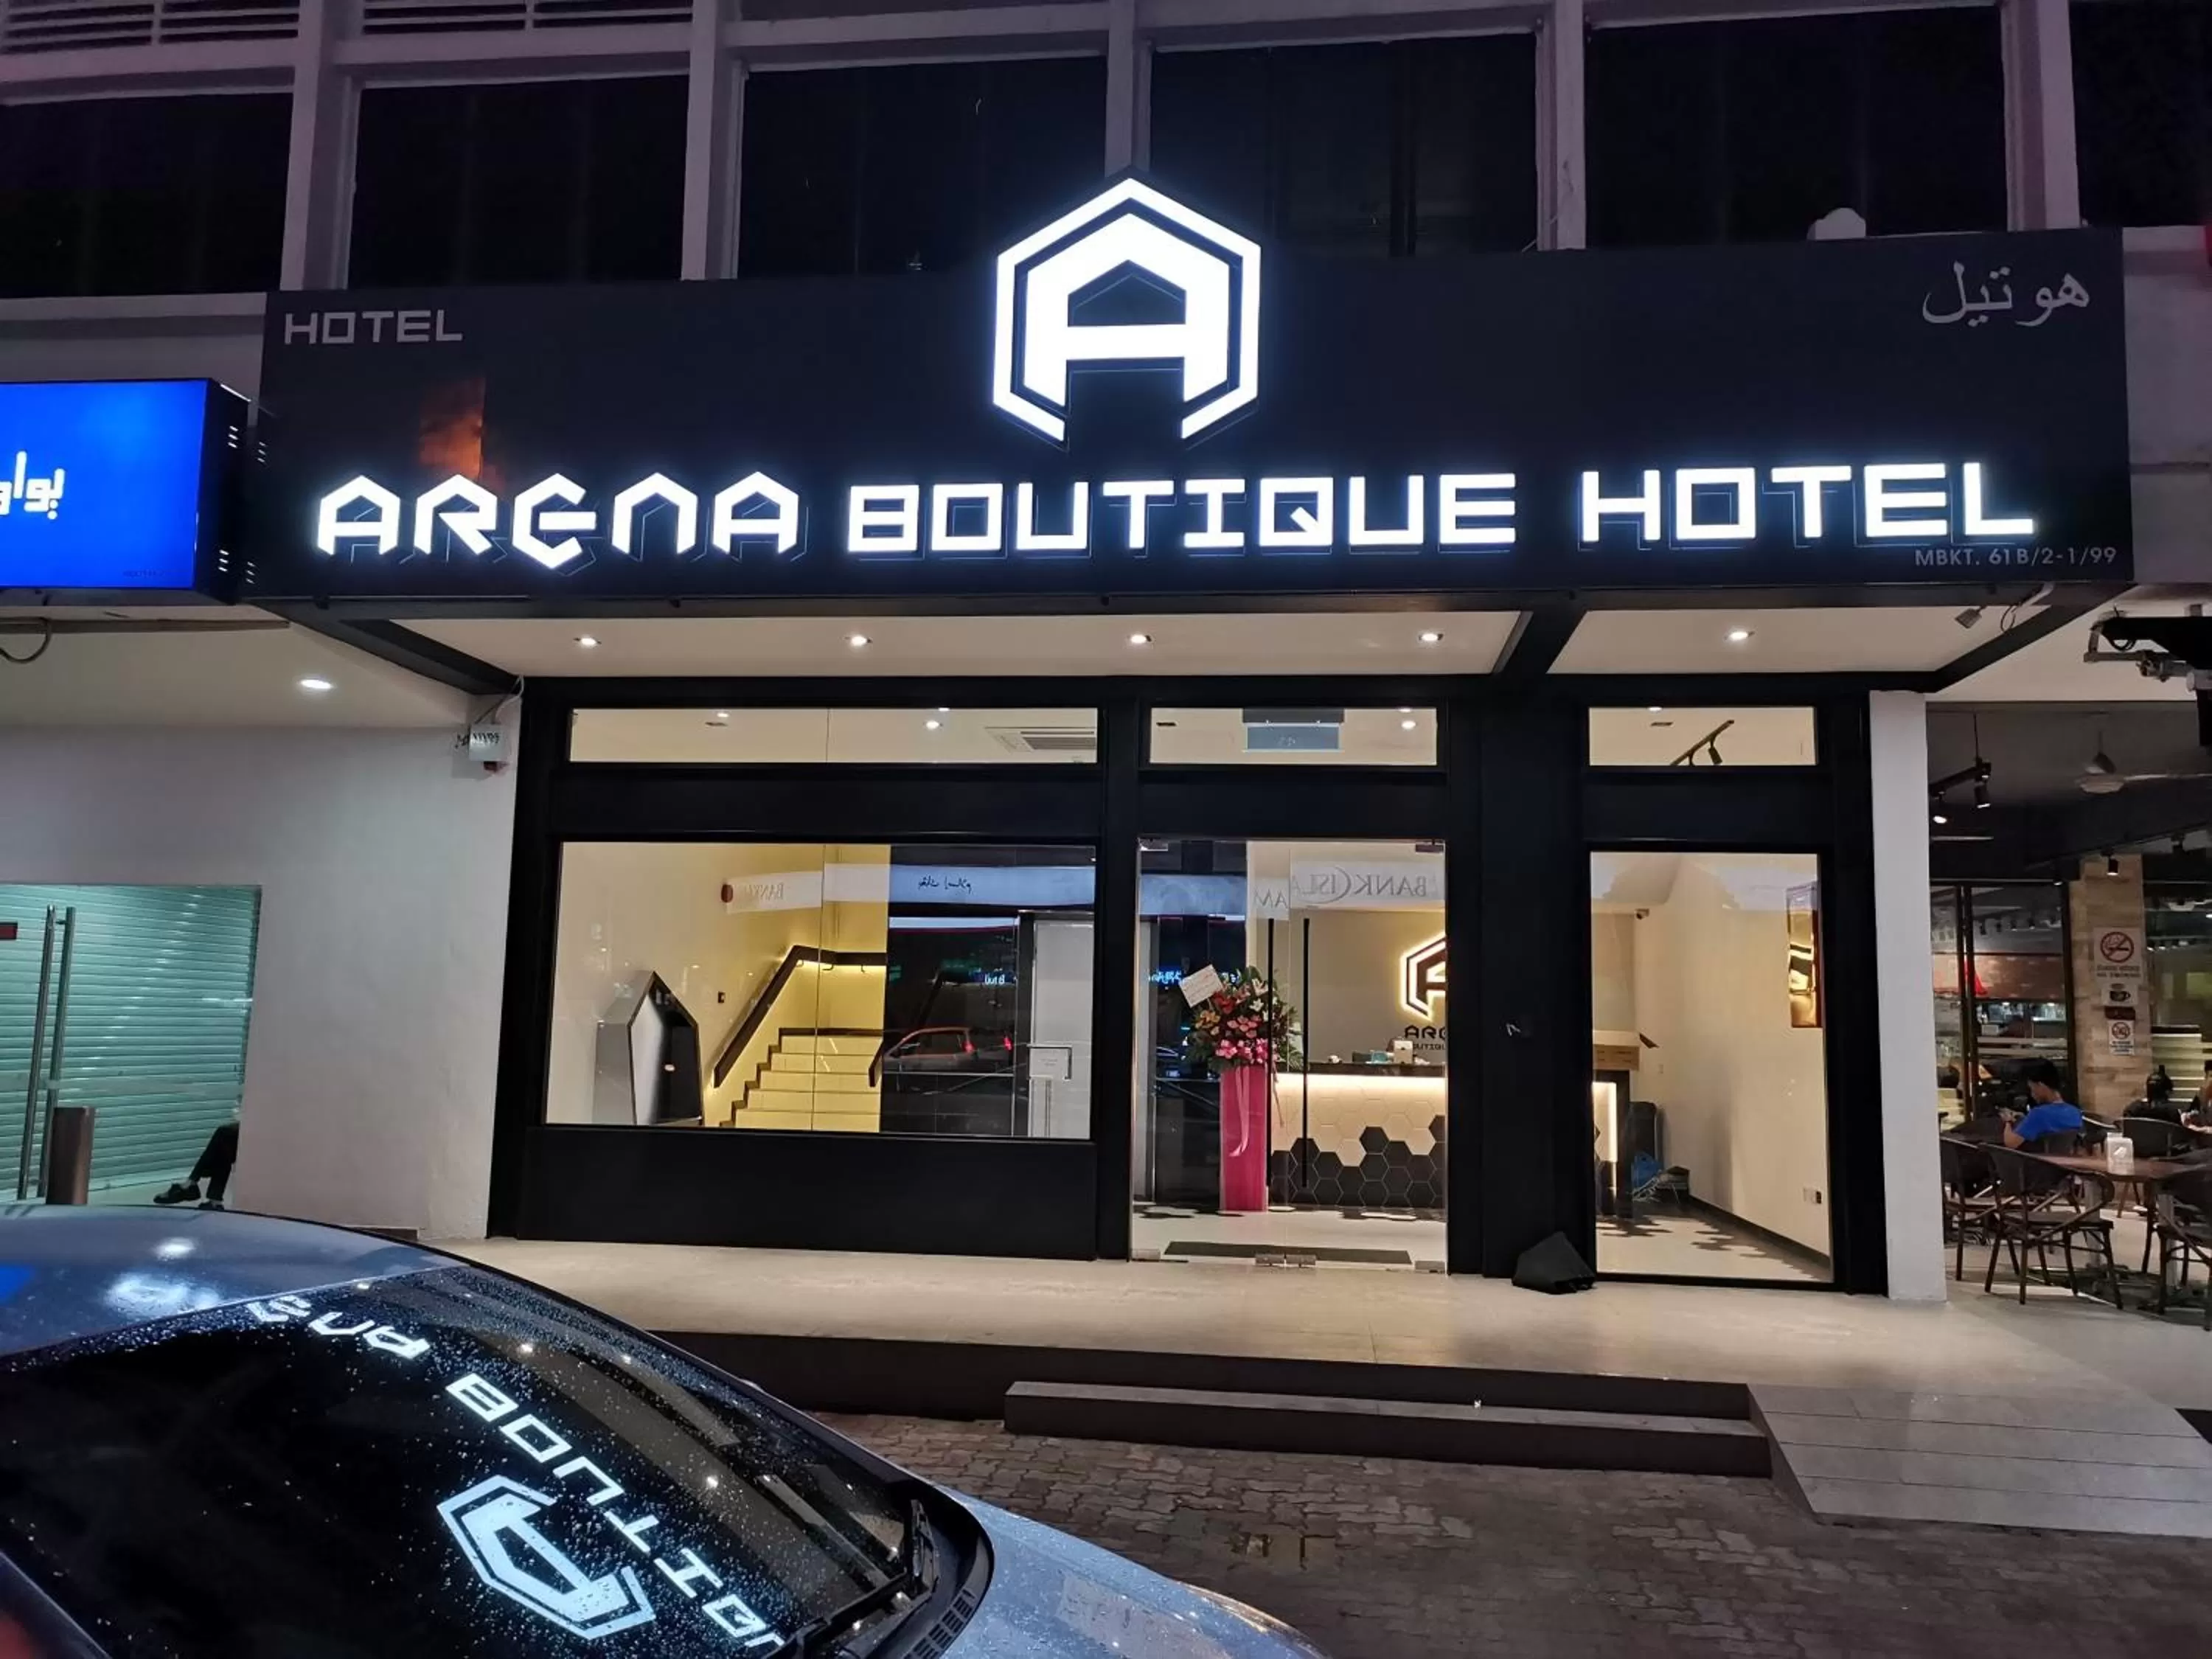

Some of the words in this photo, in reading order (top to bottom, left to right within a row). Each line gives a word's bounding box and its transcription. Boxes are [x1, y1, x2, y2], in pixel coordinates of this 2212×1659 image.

[285, 310, 463, 344] HOTEL
[317, 471, 799, 570] ARENA
[848, 473, 1516, 552] BOUTIQUE
[1582, 462, 2034, 542] HOTEL
[1915, 549, 1980, 566] MBKT.
